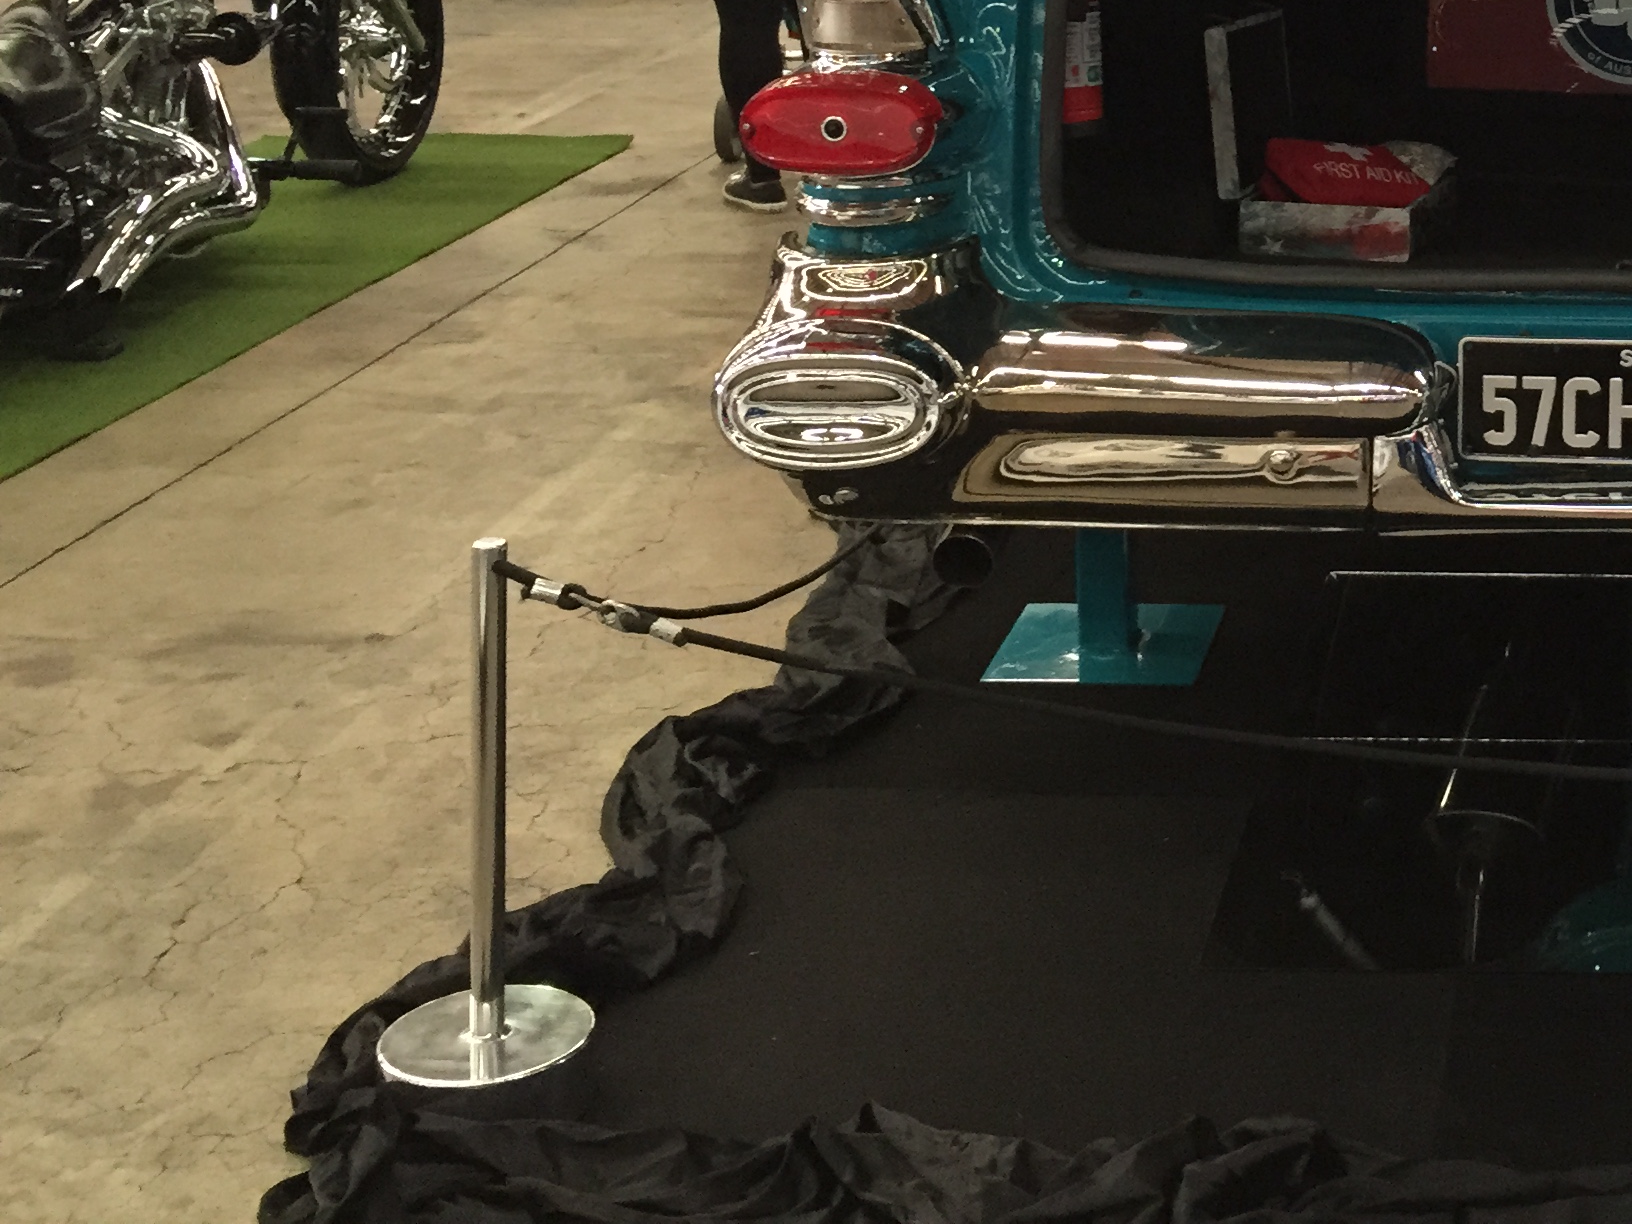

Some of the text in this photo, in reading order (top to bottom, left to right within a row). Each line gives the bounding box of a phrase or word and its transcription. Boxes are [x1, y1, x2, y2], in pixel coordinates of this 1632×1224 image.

[1312, 160, 1419, 187] FIRST AID KIT
